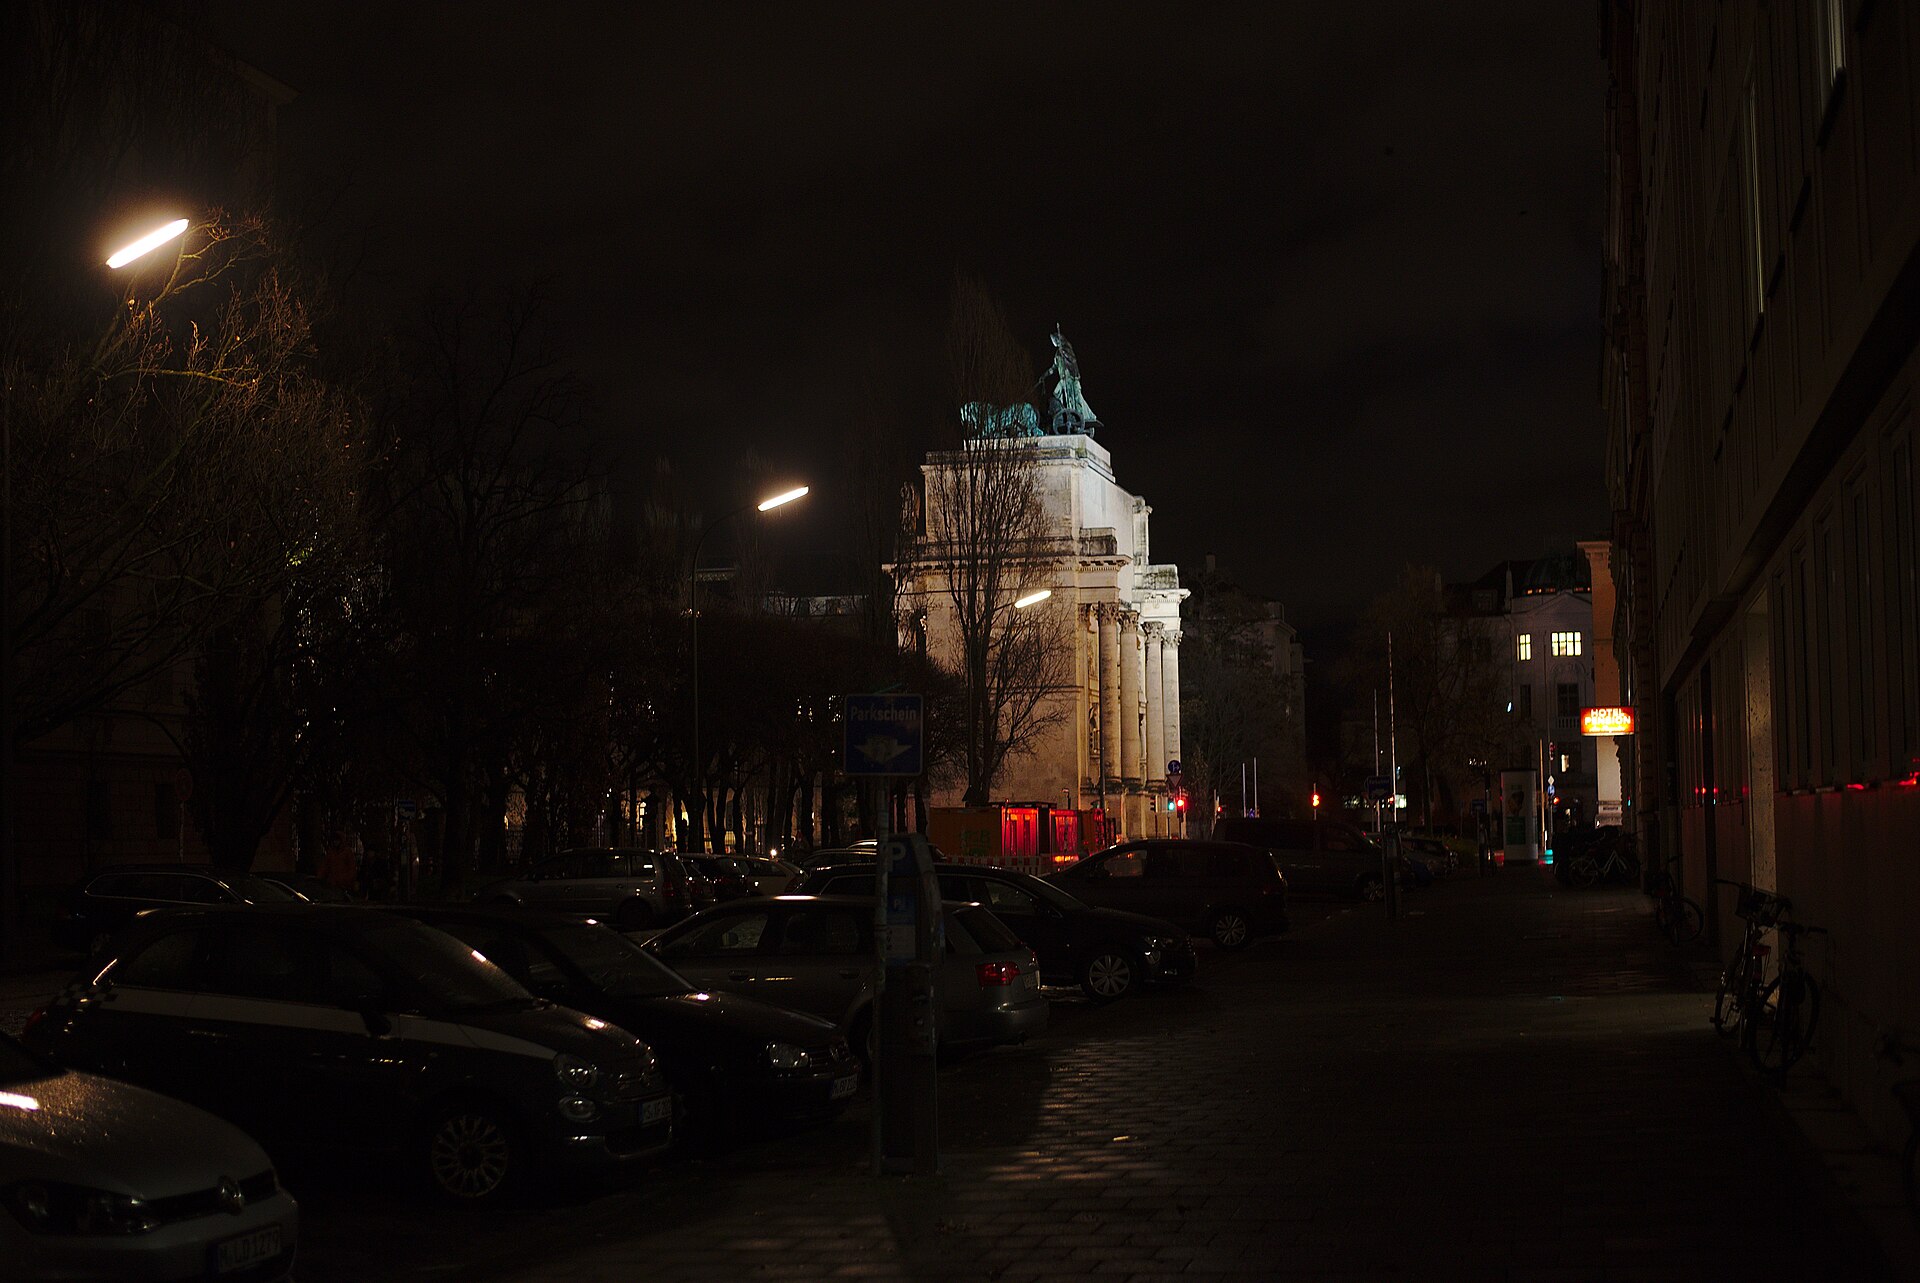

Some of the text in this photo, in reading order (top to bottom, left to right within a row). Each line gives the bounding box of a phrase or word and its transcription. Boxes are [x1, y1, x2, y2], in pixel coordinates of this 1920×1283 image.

[850, 703, 917, 721] Parkschein
[1590, 708, 1625, 717] HOTEL
[1584, 715, 1631, 726] PENSION
[887, 842, 906, 872] P
